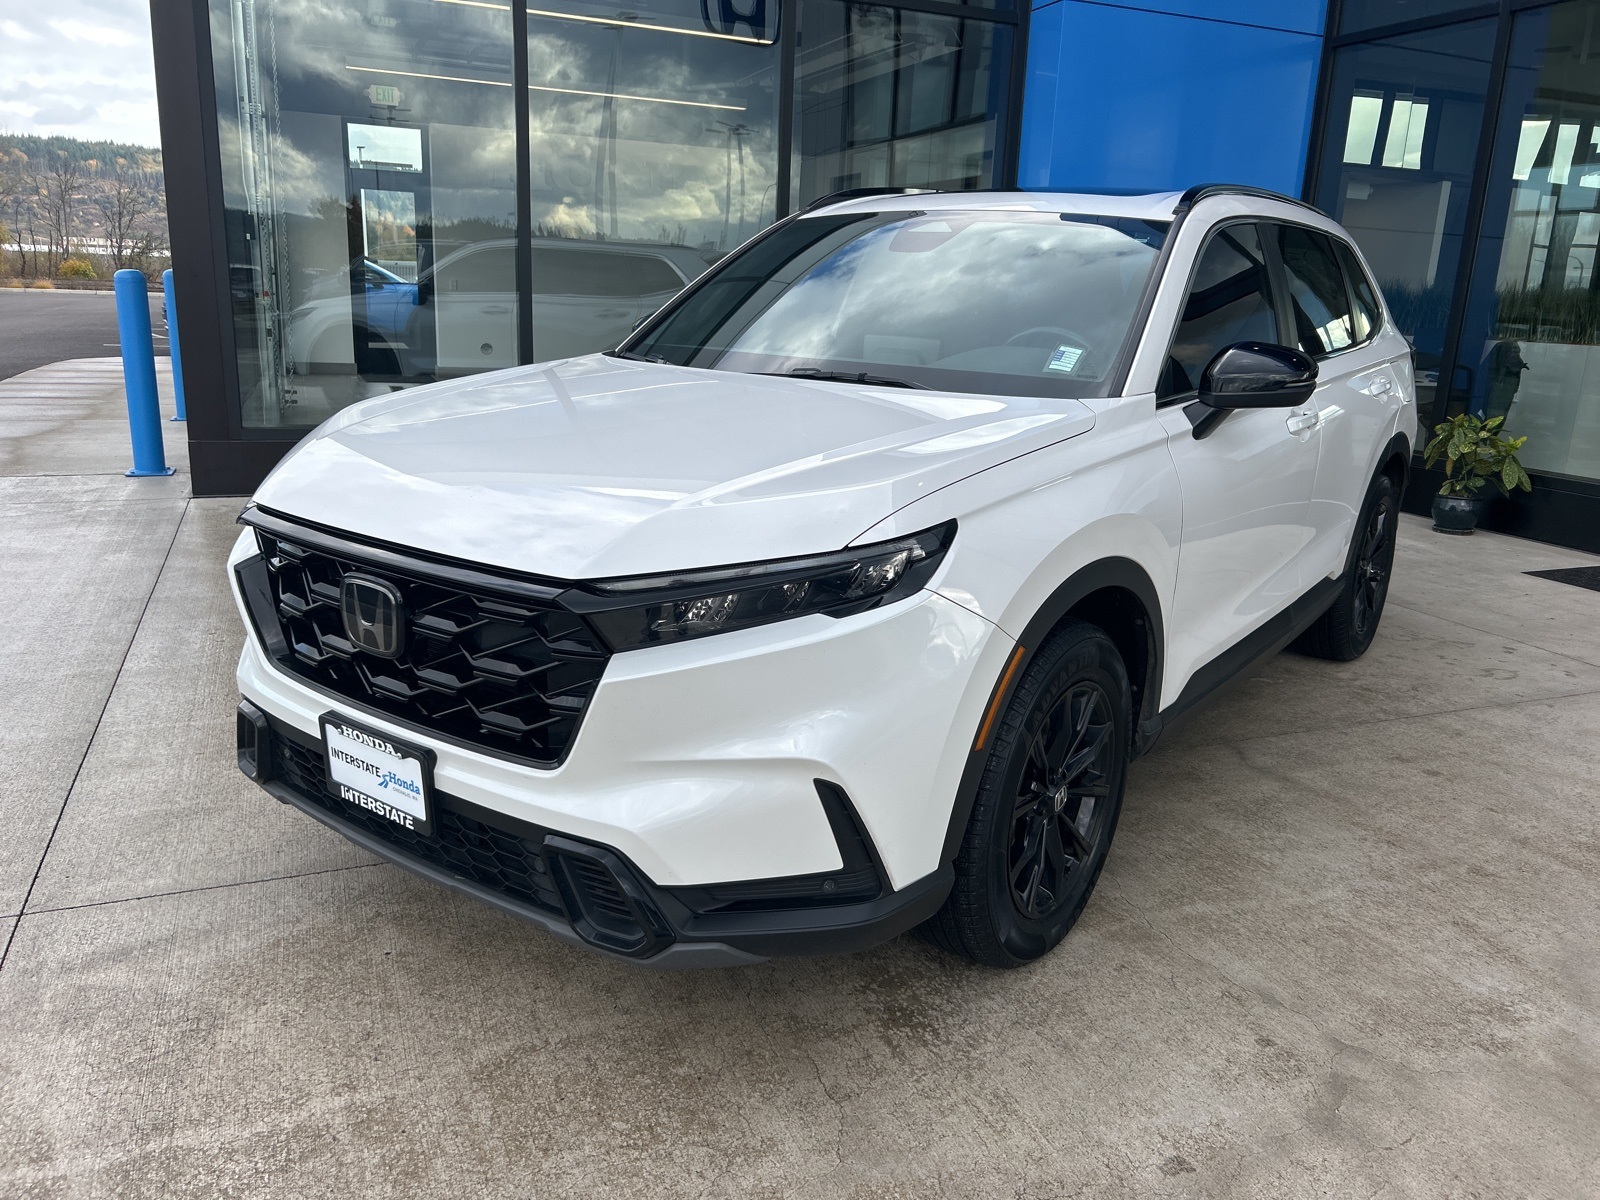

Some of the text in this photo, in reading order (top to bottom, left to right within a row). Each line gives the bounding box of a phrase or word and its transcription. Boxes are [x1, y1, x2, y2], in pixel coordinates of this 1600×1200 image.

[375, 86, 394, 103] EXIT
[341, 725, 397, 756] HONDA
[331, 746, 381, 778] INTERSTATE
[388, 771, 421, 795] Honda
[340, 785, 414, 830] INTERSTATE
